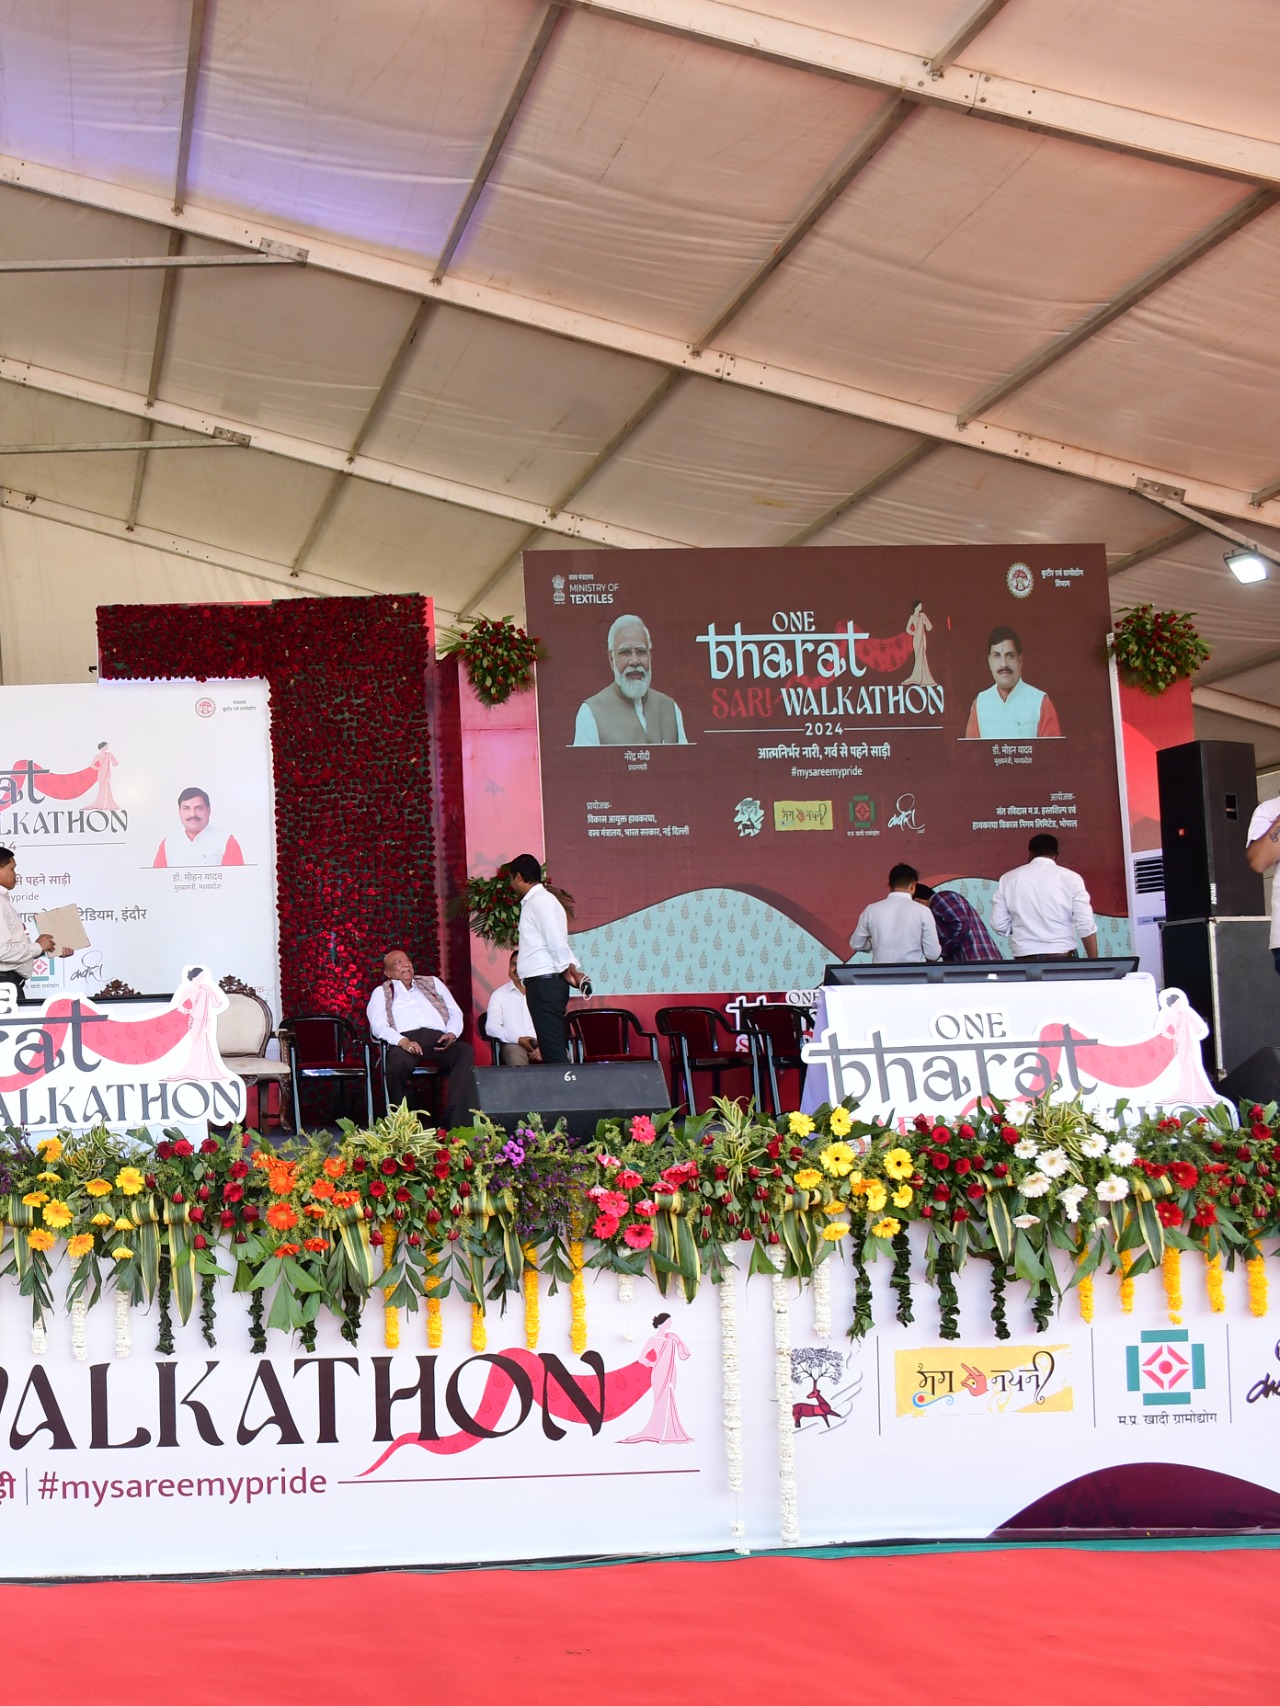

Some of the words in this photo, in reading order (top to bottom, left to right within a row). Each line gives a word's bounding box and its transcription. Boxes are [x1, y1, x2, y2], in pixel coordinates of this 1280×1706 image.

[569, 584, 606, 592] MINISTRY
[607, 583, 619, 592] OF
[569, 594, 614, 604] TEXTILES
[772, 611, 816, 632] ONE
[695, 620, 870, 680] bharat
[712, 687, 773, 719] SARI
[780, 685, 945, 716] WALKATHON
[804, 722, 844, 736] 2024
[757, 743, 800, 759] आत्मनिर्भर
[802, 743, 823, 760] नारी,
[824, 742, 838, 758] गर्व
[839, 742, 848, 757] से
[850, 742, 868, 759] पहने
[870, 742, 891, 760] साड़ी
[791, 766, 863, 779] #mysareemypride
[26, 873, 46, 886] पहने
[48, 873, 71, 887] साड़ी
[184, 871, 202, 882] मोहन
[204, 873, 223, 881] यादव
[120, 908, 147, 922] इंदौर
[934, 1012, 1007, 1040] ONE
[808, 1023, 1098, 1104] bharat
[1117, 1415, 1139, 1426] म.प्र.
[1143, 1410, 1169, 1425] खादी
[1172, 1409, 1217, 1424] ग्रामोद्योग
[37, 1467, 328, 1508] #mysareemypride
